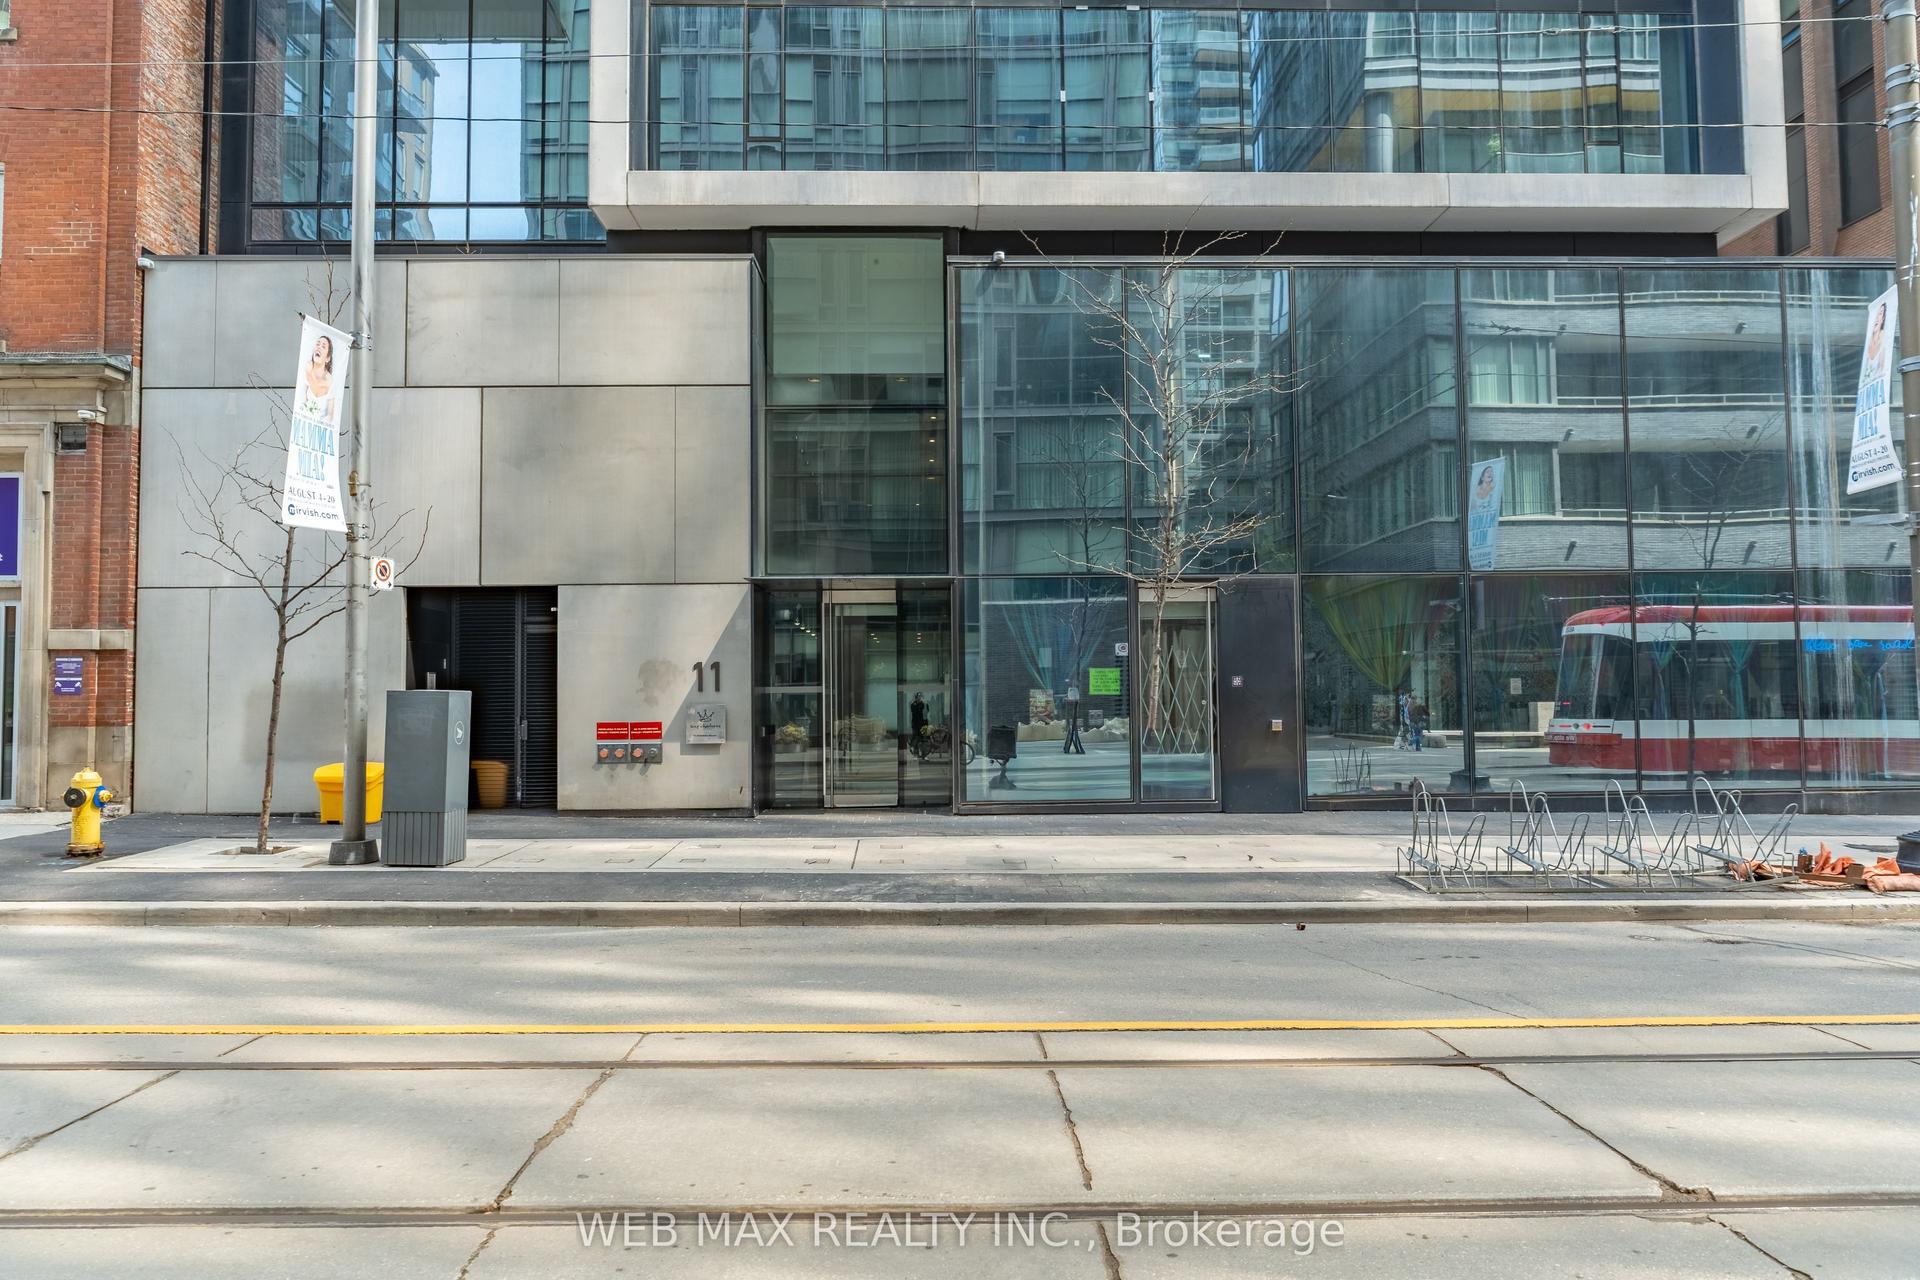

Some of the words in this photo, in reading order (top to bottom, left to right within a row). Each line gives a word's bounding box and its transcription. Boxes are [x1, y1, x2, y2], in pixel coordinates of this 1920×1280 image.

[296, 448, 325, 481] MIA!
[288, 486, 316, 500] AUGUST
[692, 661, 721, 693] 11
